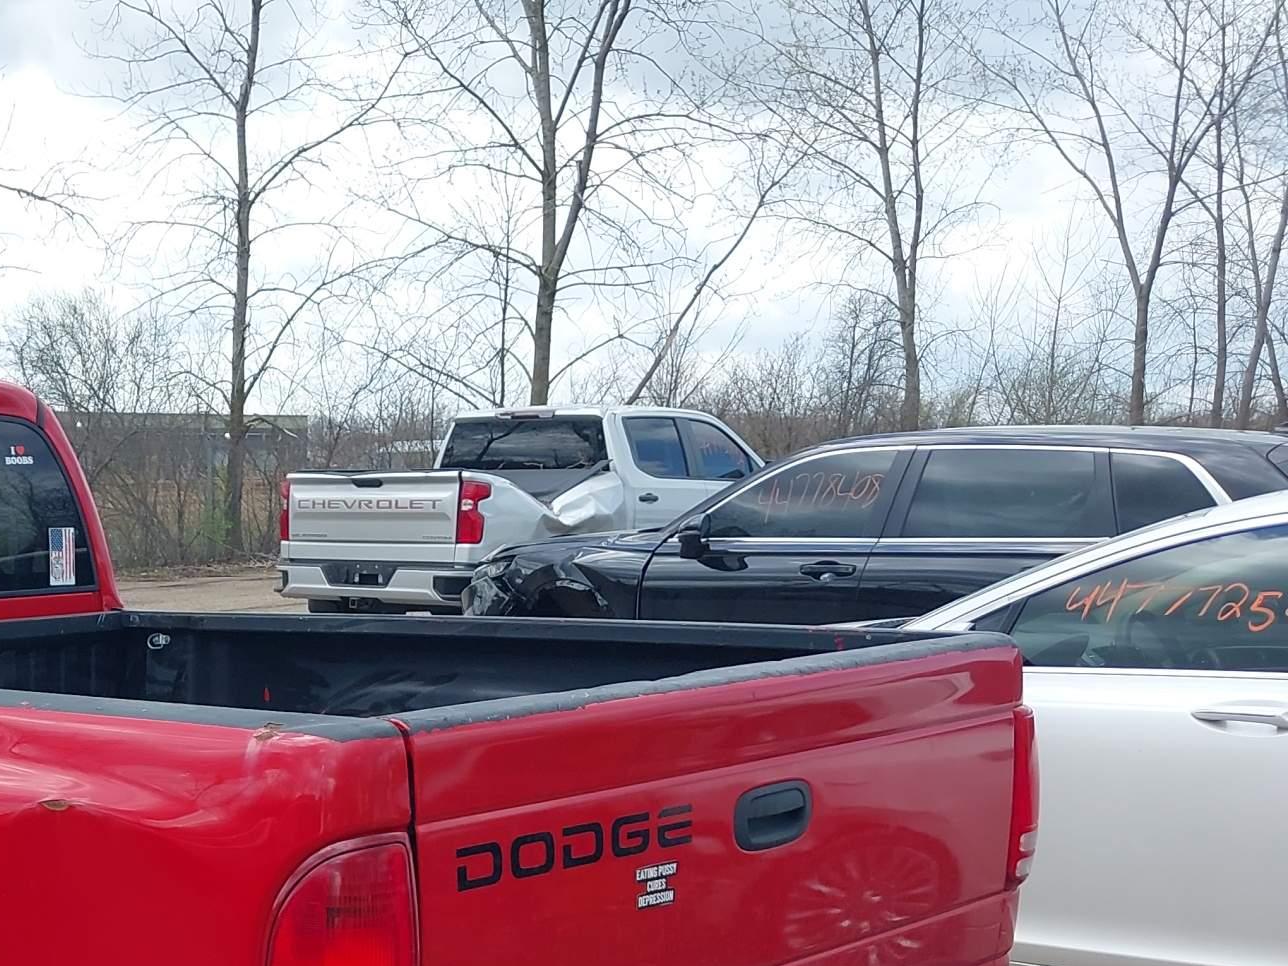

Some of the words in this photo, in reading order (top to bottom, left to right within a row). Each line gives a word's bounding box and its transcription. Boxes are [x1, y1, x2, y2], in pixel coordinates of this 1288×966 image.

[5, 456, 33, 465] BOOBS
[297, 498, 443, 510] CHEVROLET
[1065, 577, 1288, 632] 4477725
[456, 803, 693, 892] DODGE
[636, 865, 658, 881] EATING
[658, 862, 678, 877] PUSSY
[647, 878, 667, 892] CURES
[638, 889, 674, 908] DEPRESSION
